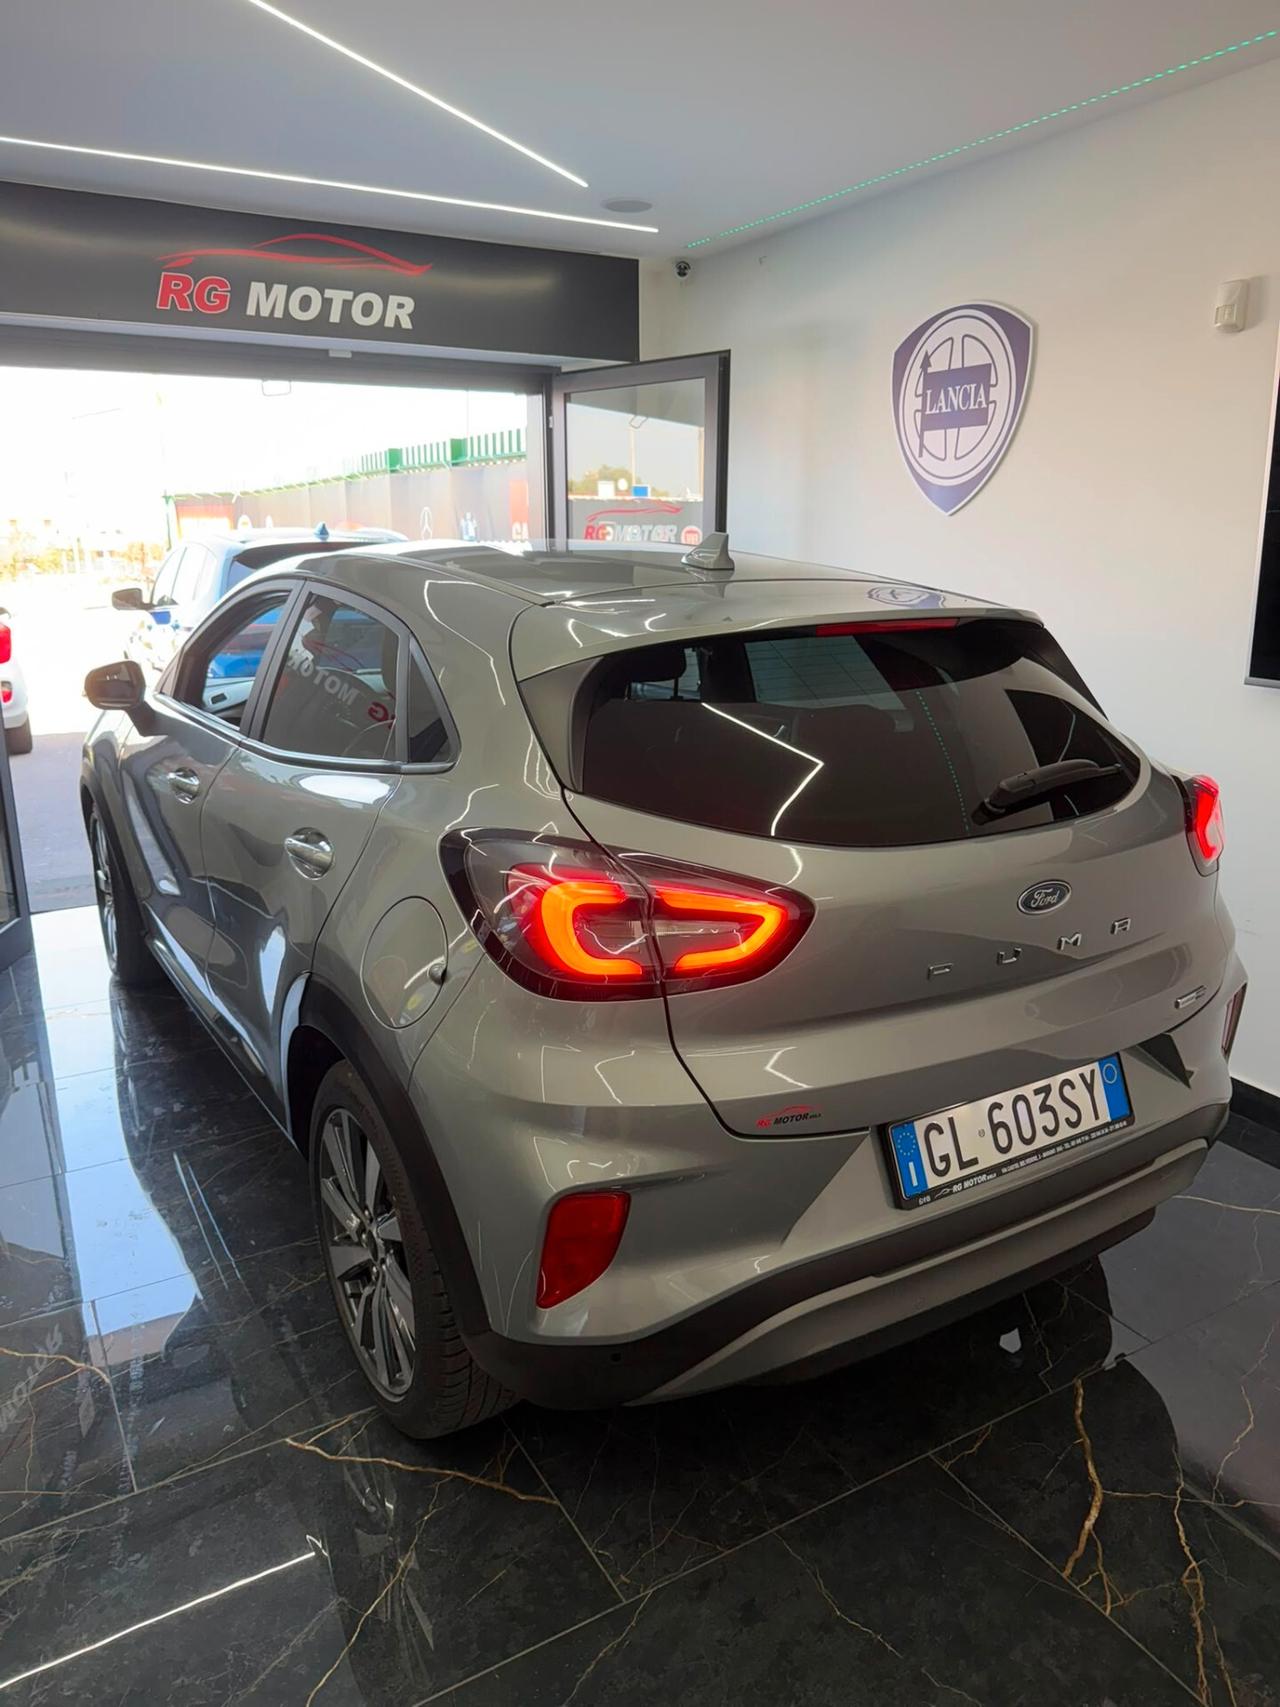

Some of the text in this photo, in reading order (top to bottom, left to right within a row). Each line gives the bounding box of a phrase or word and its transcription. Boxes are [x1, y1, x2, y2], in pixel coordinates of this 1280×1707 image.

[156, 272, 415, 330] RG MOTOR
[925, 383, 987, 415] LANCIA
[927, 917, 1131, 980] PUMA
[773, 1112, 809, 1125] MOTOR
[923, 1116, 979, 1177] GL
[987, 1068, 1100, 1154] 603SY
[952, 1183, 963, 1193] RG
[964, 1173, 987, 1189] MOTOR
